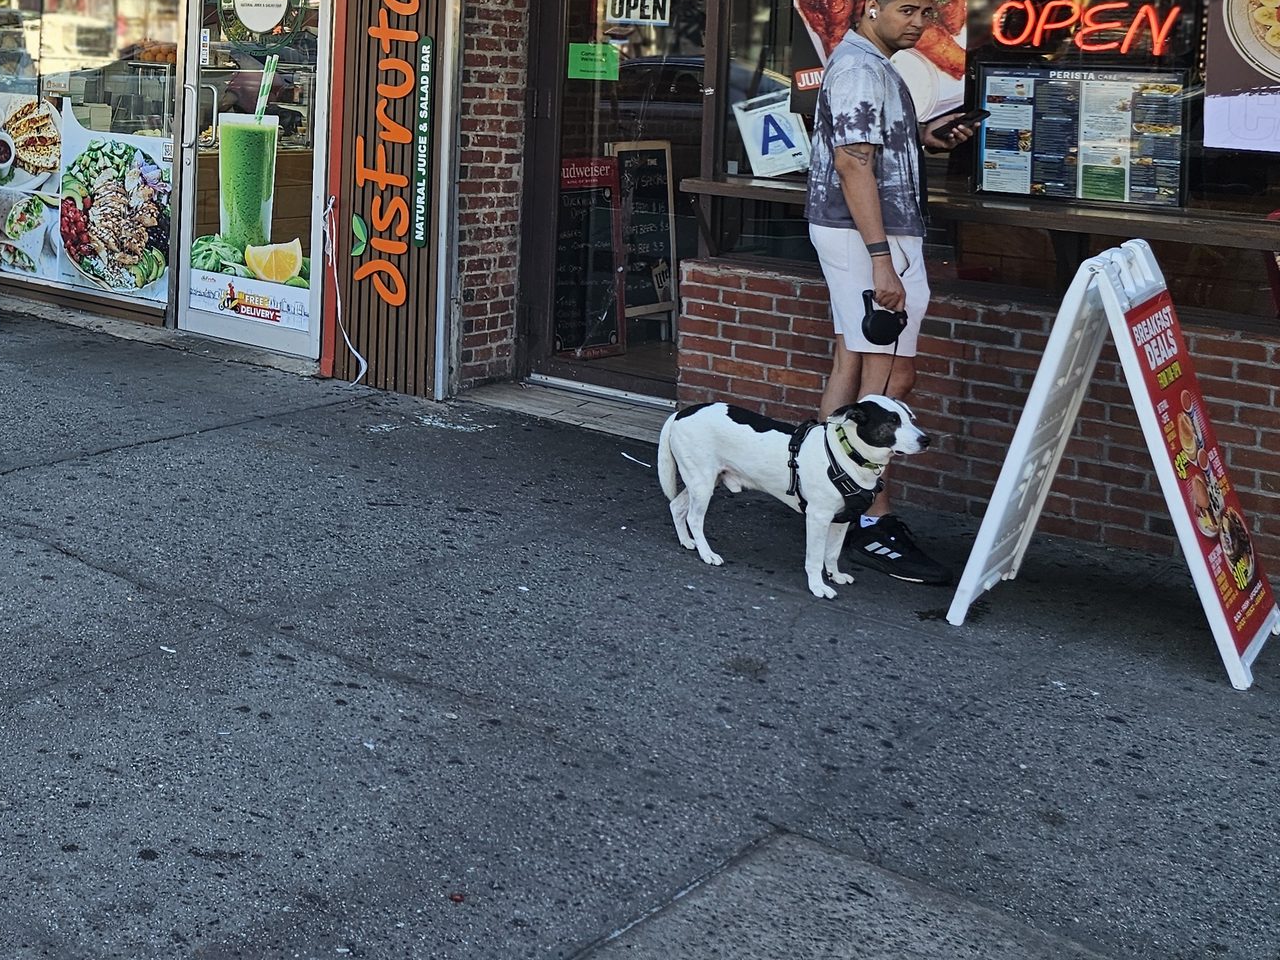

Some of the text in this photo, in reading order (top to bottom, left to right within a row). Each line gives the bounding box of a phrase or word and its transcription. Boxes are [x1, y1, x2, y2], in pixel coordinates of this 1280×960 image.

[992, 0, 1181, 56] OPEN
[1049, 71, 1095, 80] PERISTA
[415, 44, 430, 240] NATURAL JUICE & SALAD BAR
[761, 113, 796, 156] A
[561, 161, 611, 179] udweiser
[241, 304, 275, 320] DELIVERY
[245, 295, 264, 306] FREE
[1132, 305, 1174, 347] BREAKFAST
[1143, 329, 1178, 371] DEALS
